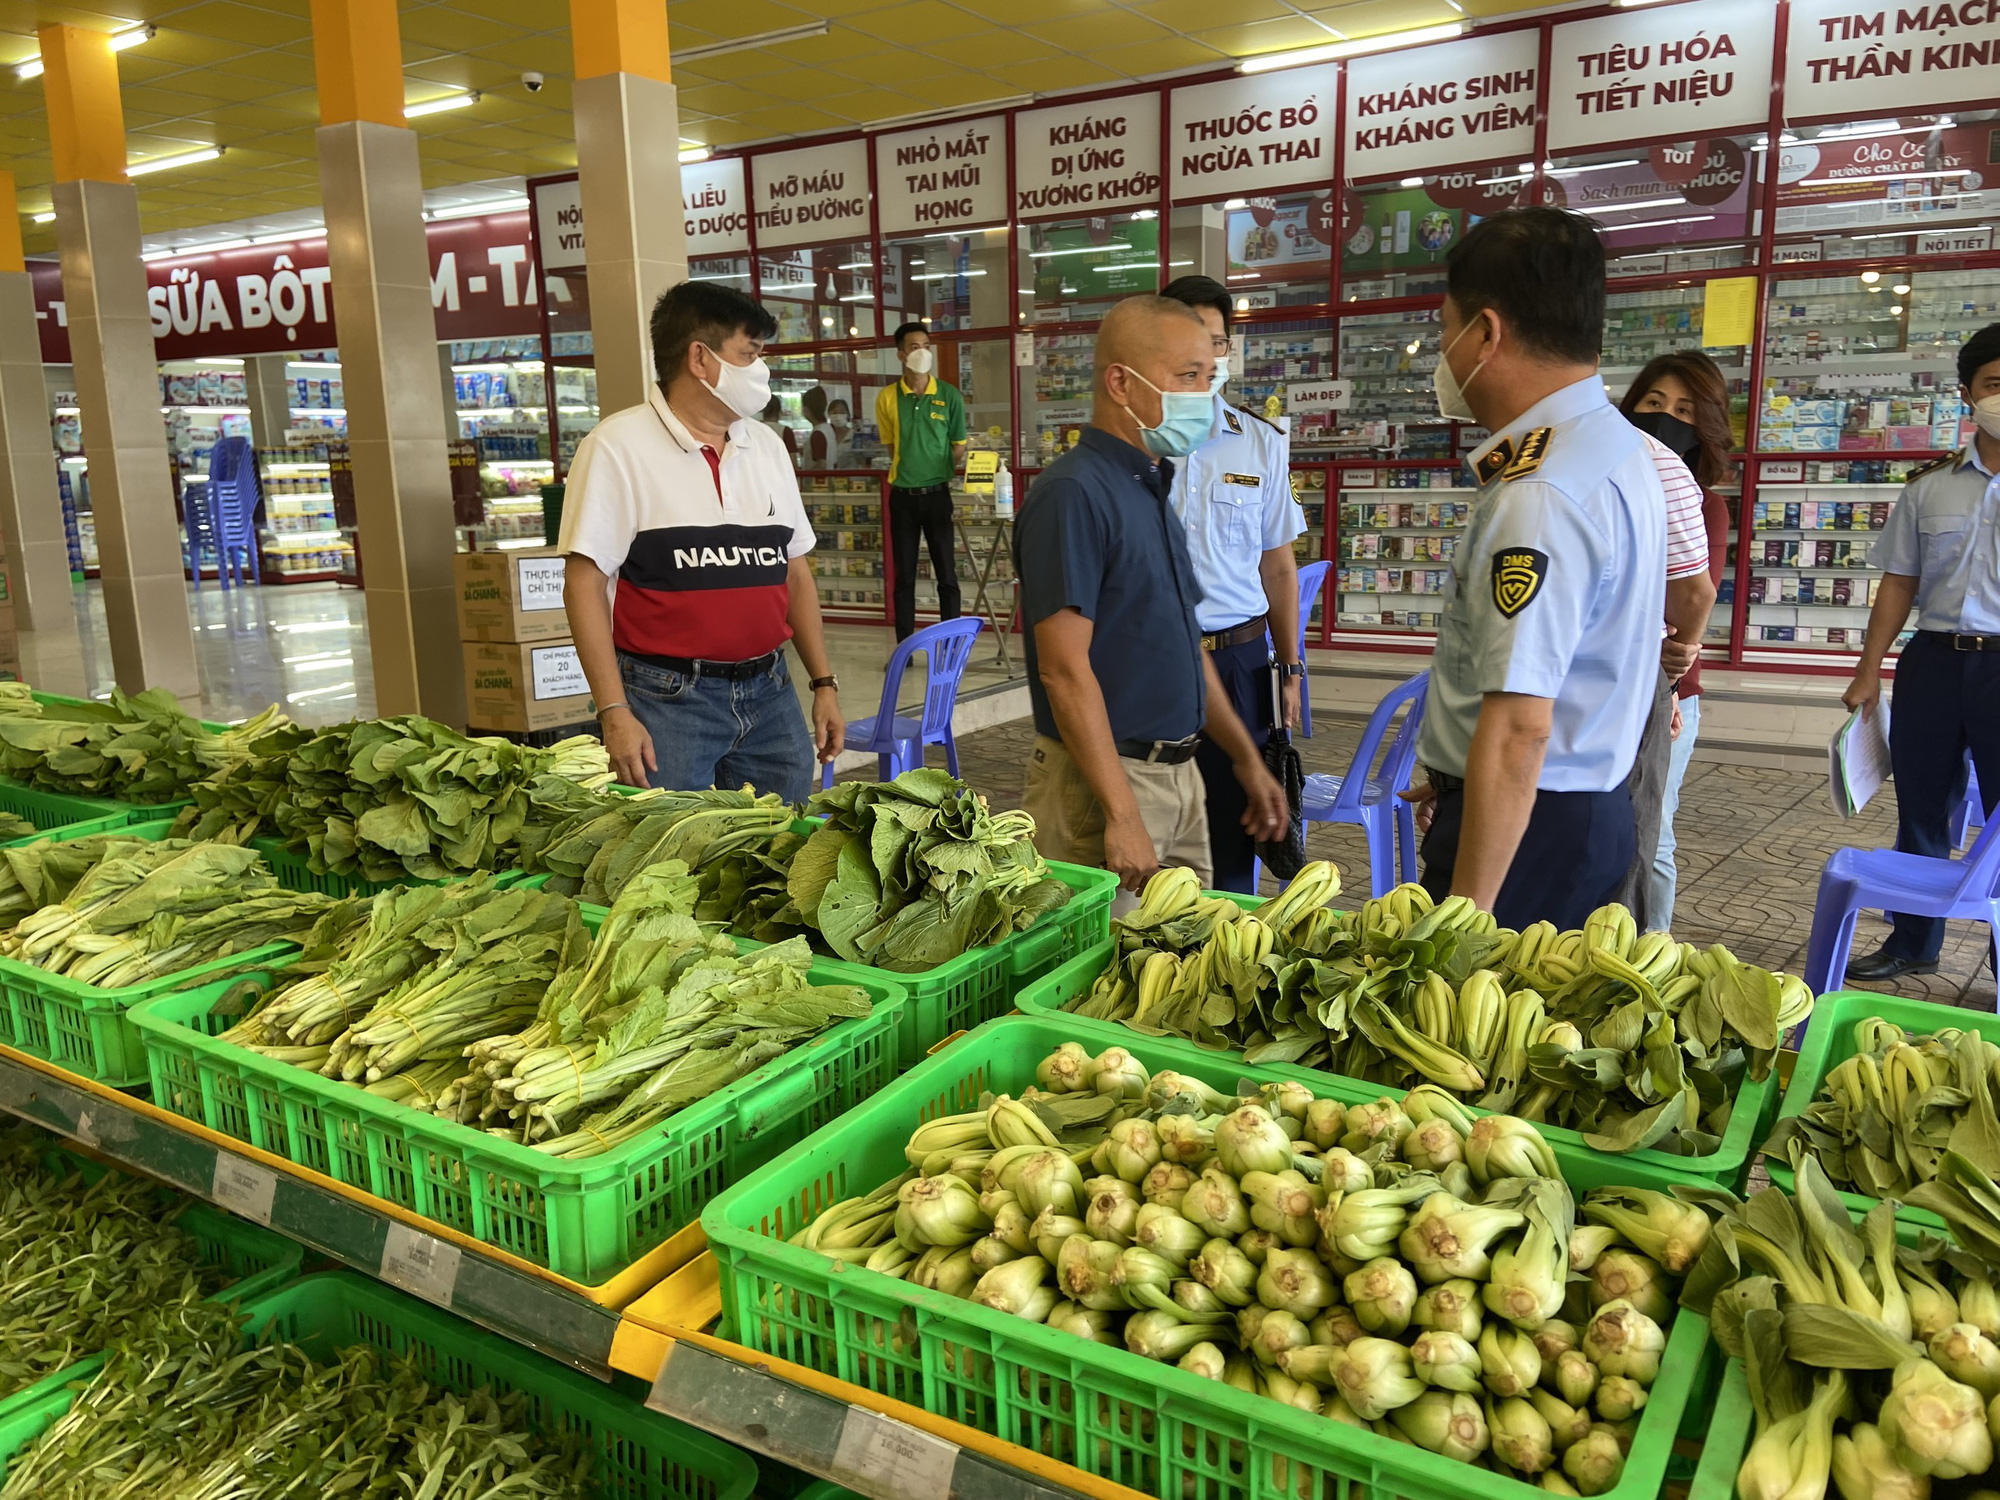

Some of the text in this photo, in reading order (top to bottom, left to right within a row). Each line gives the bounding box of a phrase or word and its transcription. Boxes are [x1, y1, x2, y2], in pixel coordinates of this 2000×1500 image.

[1818, 12, 1886, 43] TIM
[1577, 30, 1737, 78] TIÊU HÓA
[1806, 42, 1912, 84] THẦN
[1357, 69, 1535, 117] KHÁNG SINH
[1576, 69, 1735, 115] TIẾT NIỆU
[1049, 116, 1127, 146] KHÁNG
[1185, 95, 1318, 143] THUỐC BỔ
[1355, 103, 1535, 152] KHÁNG VIÊM
[897, 129, 990, 166] NHỎ MẮT
[1181, 137, 1321, 177] NGỪA THAI
[1853, 142, 1893, 164] Cho
[1051, 148, 1125, 179] DỊ ỨNG
[1874, 159, 1909, 174] CHẤT
[769, 170, 844, 200] MỠ MÁU
[905, 164, 981, 194] TAI MŨI
[1018, 171, 1161, 211] XƯƠNG KHỚP
[691, 183, 727, 210] LIỄU
[1321, 197, 1349, 214] GÁ
[699, 212, 748, 237] DƯỢC
[754, 198, 864, 229] TIỂU ĐƯỜNG
[914, 198, 974, 225] HỌNG
[1925, 236, 1985, 253] NỘI TIẾT
[147, 255, 332, 343] SỮA BỘT
[1294, 389, 1343, 403] LÀM ĐẸP
[673, 545, 788, 570] NAUTICA
[1502, 554, 1534, 568] DMS
[524, 569, 550, 583] THỰC
[527, 580, 561, 594] CHỈ THỊ
[472, 586, 500, 601] CHANH
[542, 671, 582, 685] KHÁCH HÀNG
[557, 661, 569, 672] 20
[484, 675, 512, 690] CHANH
